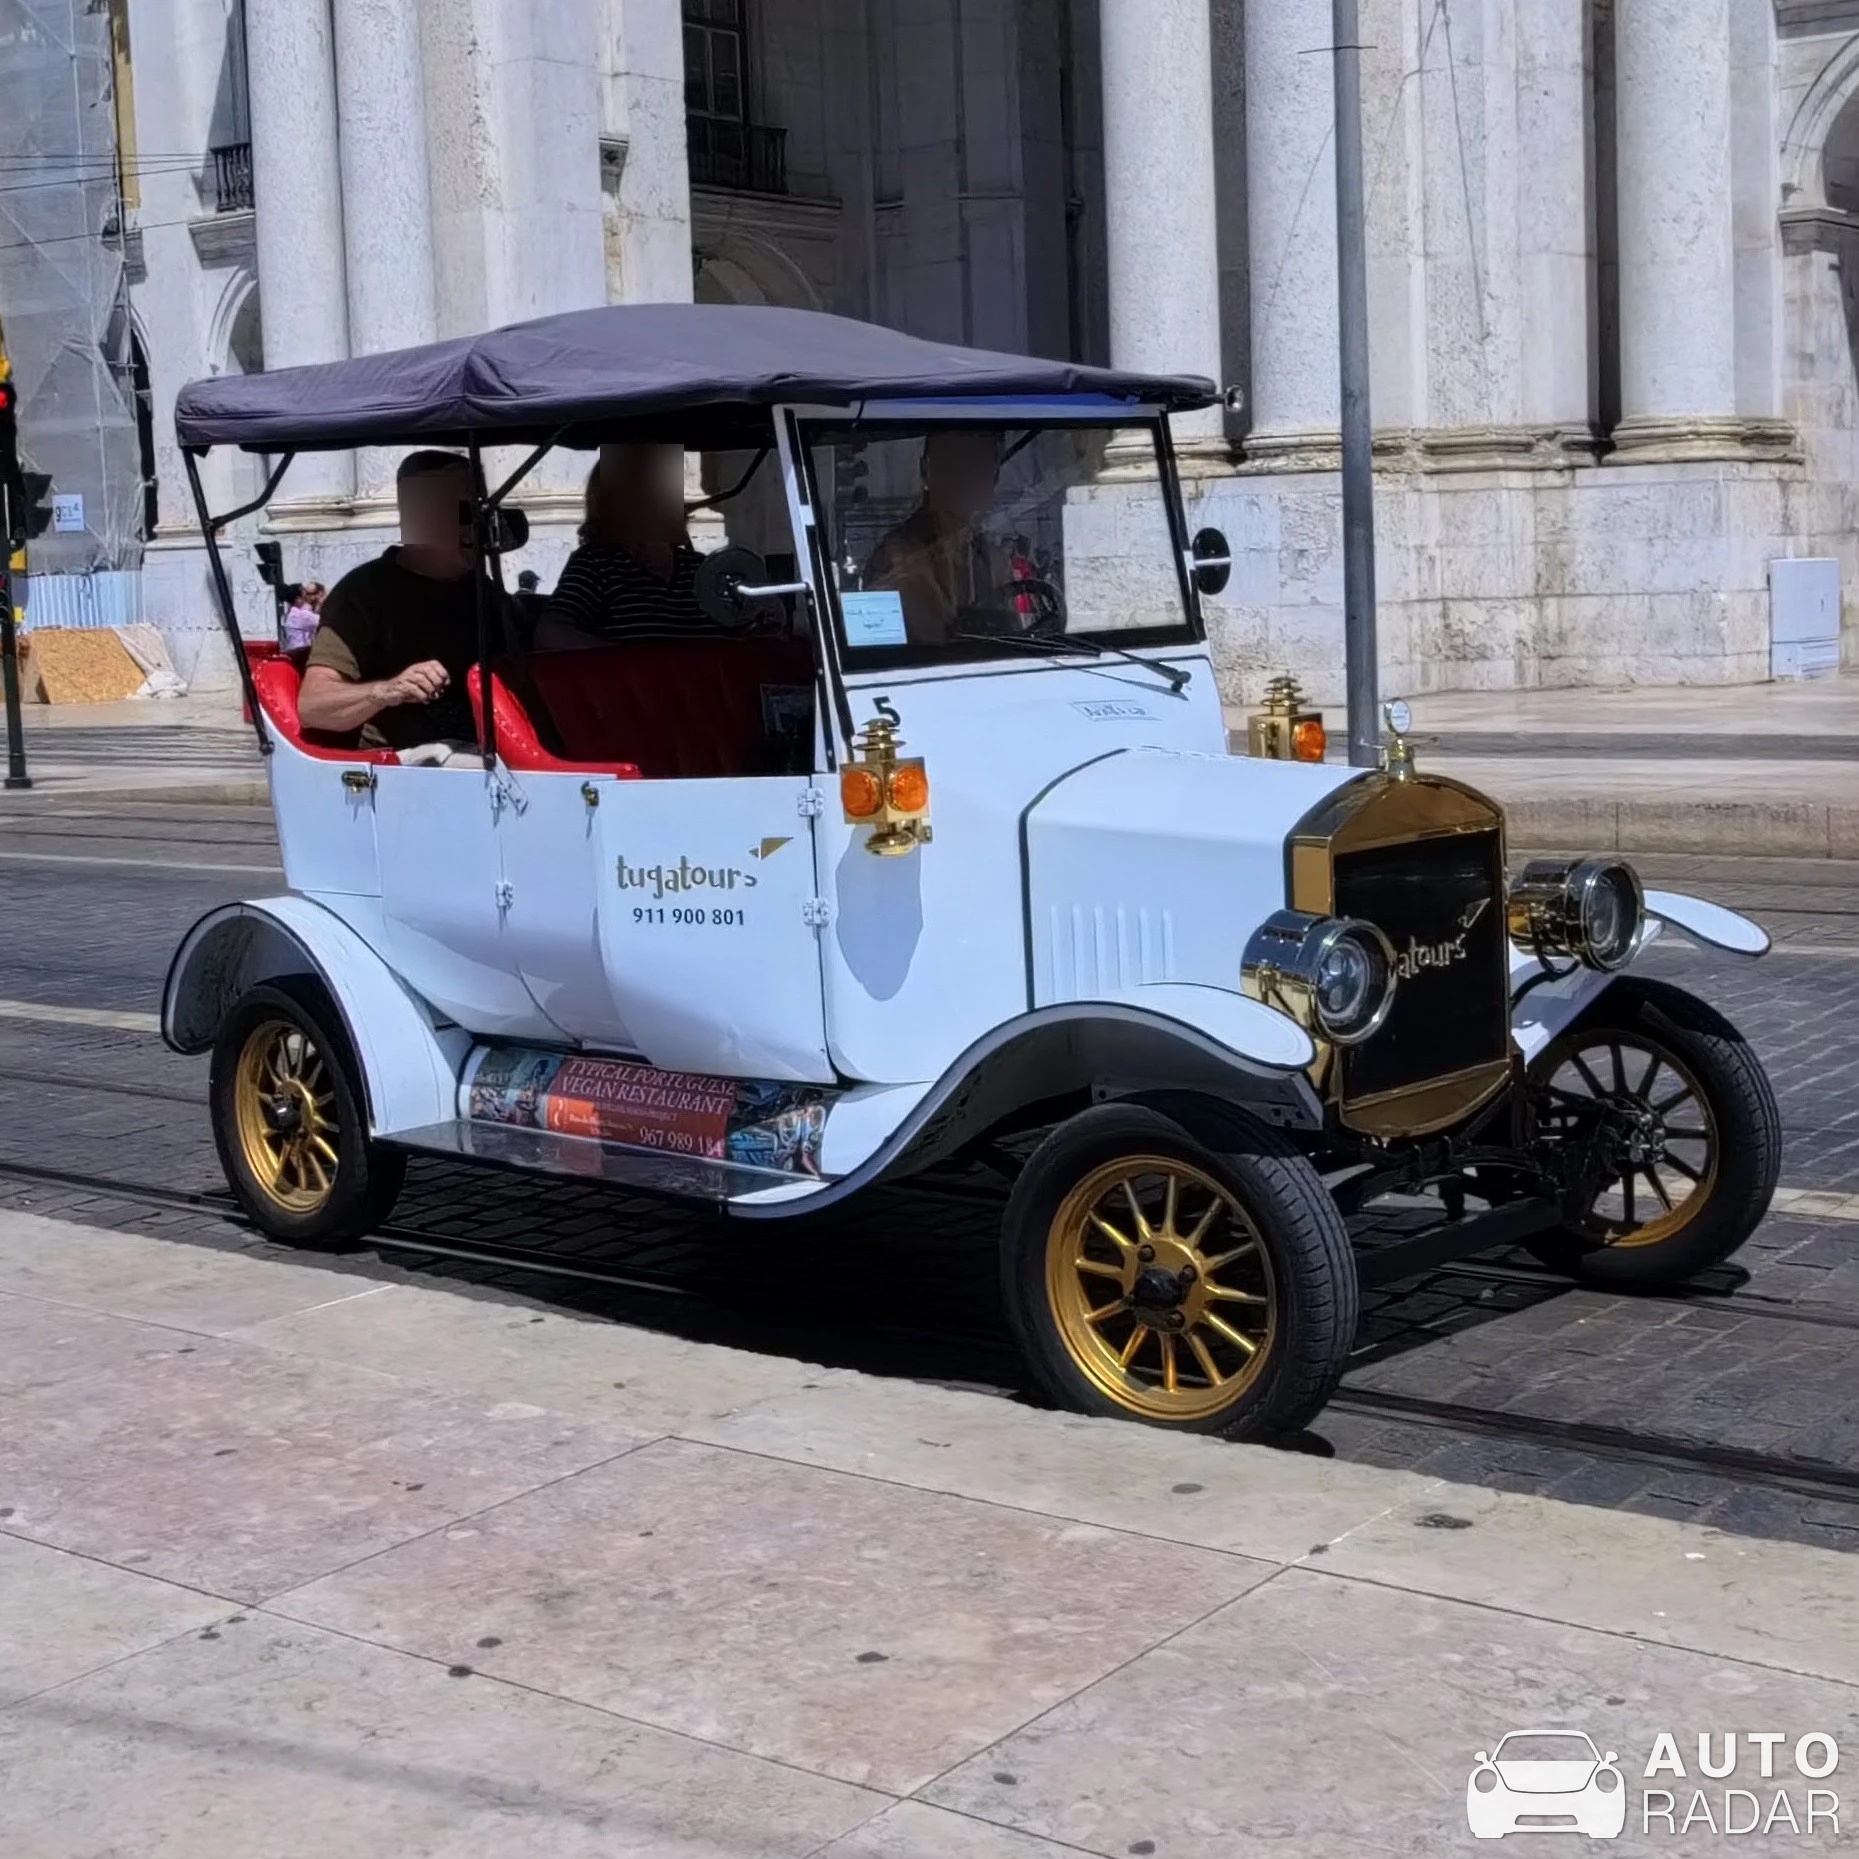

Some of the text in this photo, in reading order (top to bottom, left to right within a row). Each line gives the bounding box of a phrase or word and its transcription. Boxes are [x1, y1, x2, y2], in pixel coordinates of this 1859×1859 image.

[872, 695, 901, 728] 5
[616, 854, 758, 900] tugatours
[633, 907, 745, 926] 911 900 801
[1396, 933, 1466, 979] atours
[563, 1076, 618, 1099] VEGAN
[616, 1083, 730, 1115] RESTAURANT
[568, 1060, 736, 1096] TYPICAL PORTUGUESE
[640, 1126, 665, 1147] 967
[668, 1131, 693, 1152] 989
